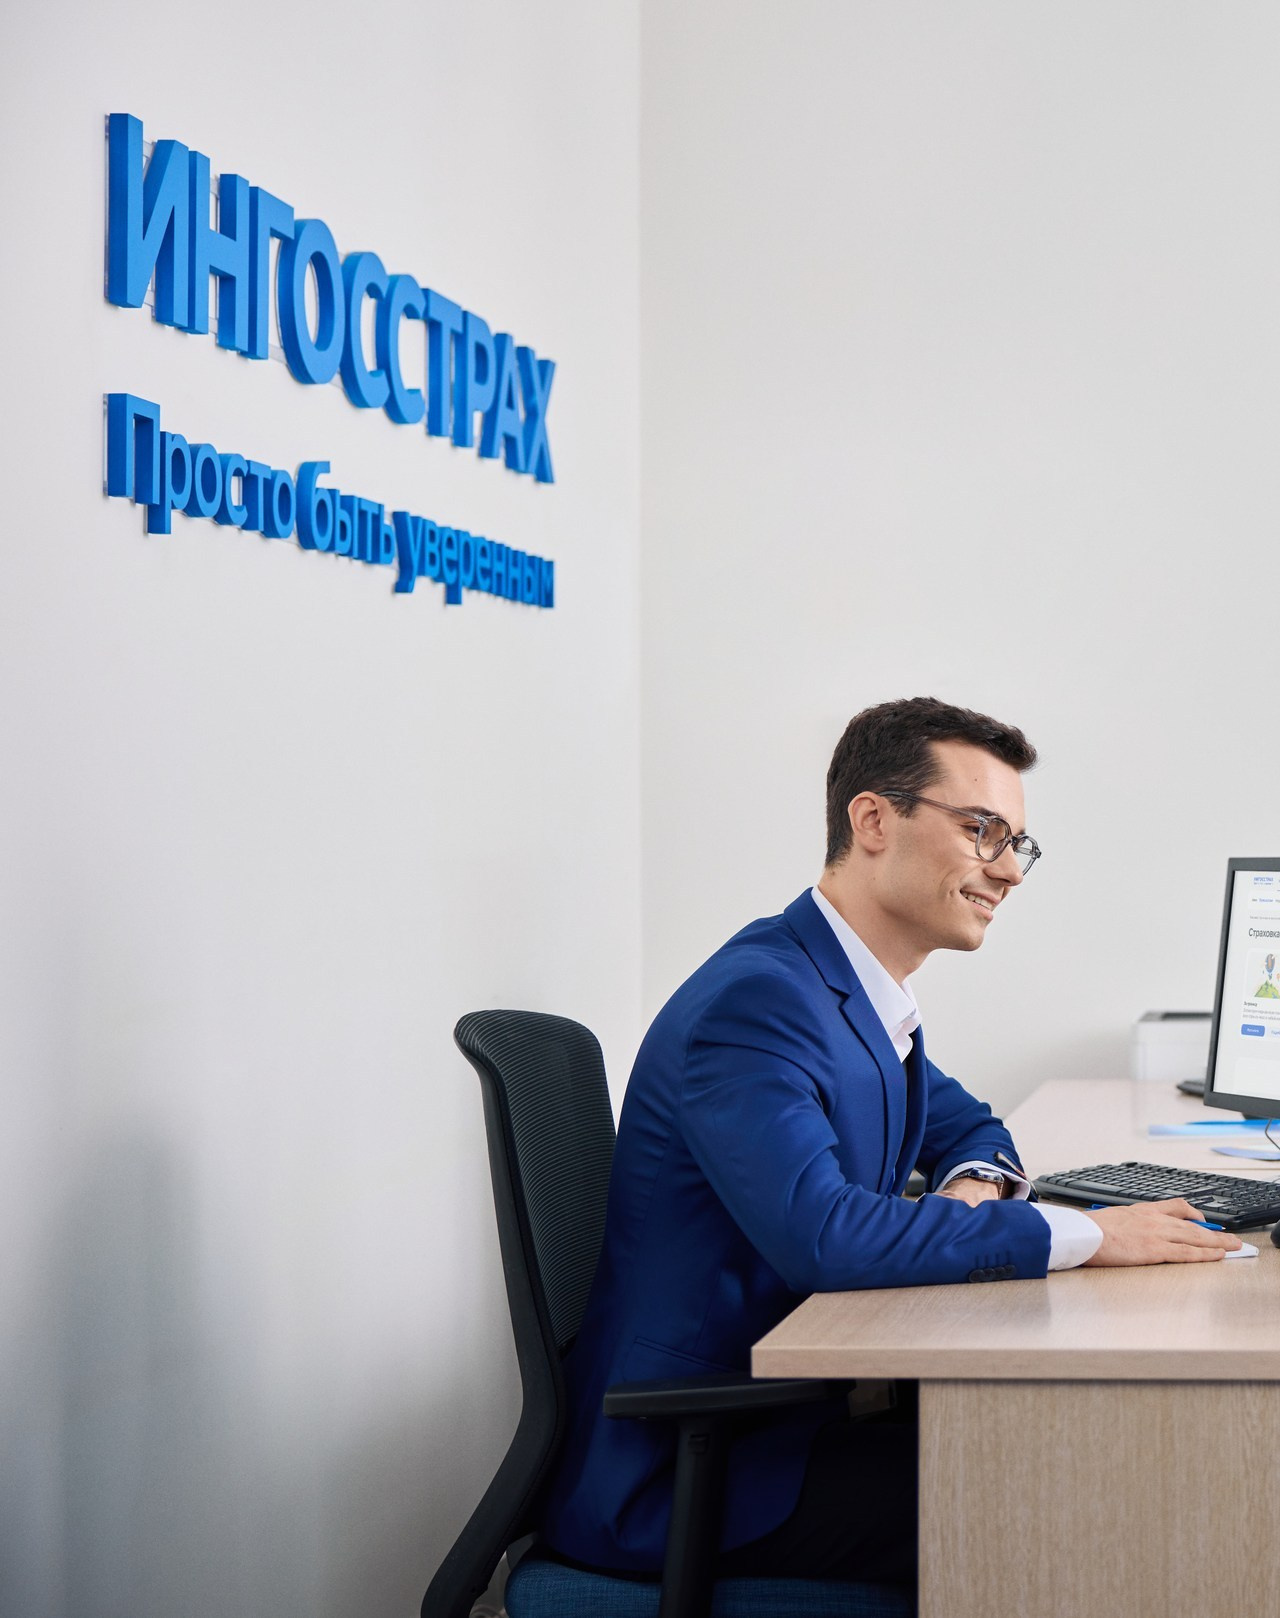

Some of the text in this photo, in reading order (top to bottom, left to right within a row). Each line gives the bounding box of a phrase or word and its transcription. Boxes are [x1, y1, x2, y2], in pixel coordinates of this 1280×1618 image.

[108, 113, 556, 482] ИНГОССТРАХ
[106, 393, 554, 608] Просто быть уверенным
[1248, 927, 1280, 939] Страховка
